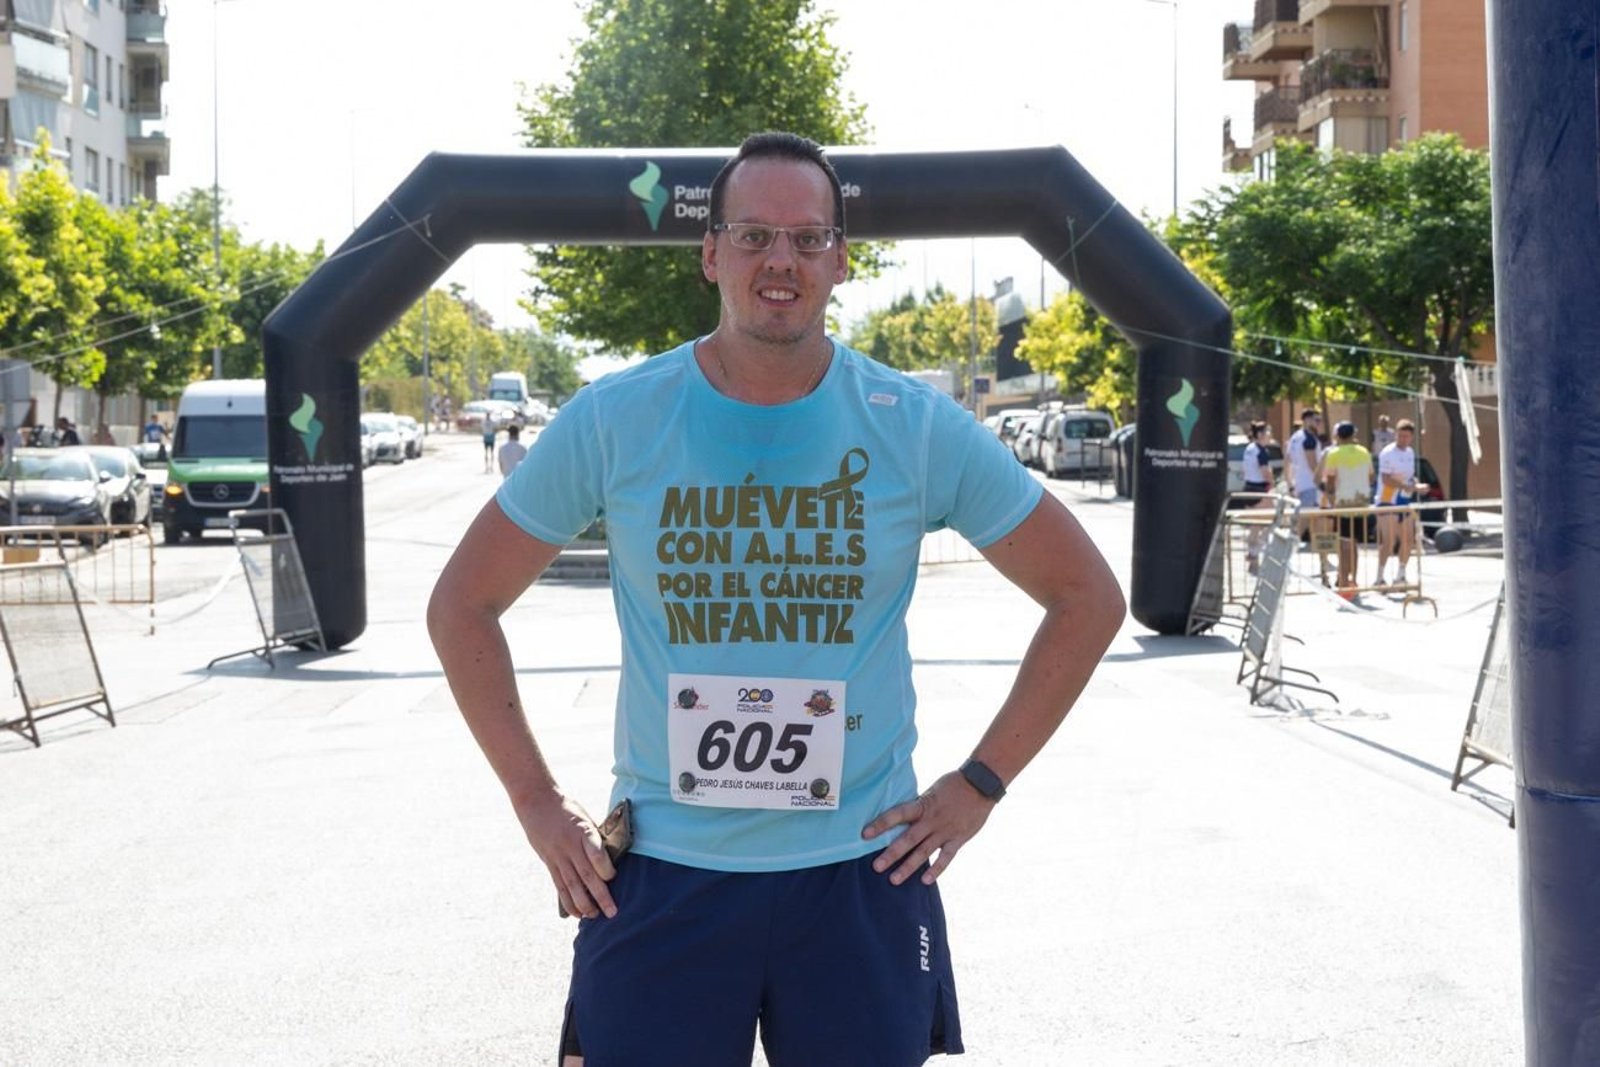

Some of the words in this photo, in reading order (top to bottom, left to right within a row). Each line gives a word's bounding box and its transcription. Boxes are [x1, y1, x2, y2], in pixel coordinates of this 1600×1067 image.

[674, 203, 710, 221] Dep
[658, 472, 866, 531] MUÉVETE
[656, 531, 732, 565] CON
[744, 531, 867, 567] A.L.E.S
[657, 572, 713, 598] POR
[722, 572, 751, 598] EL
[760, 566, 865, 600] CÁNCER
[663, 601, 855, 645] INFANTIL
[697, 720, 813, 774] 605
[695, 778, 718, 788] PEDRO
[720, 779, 743, 790] JESÚS
[744, 780, 774, 791] CHAVES
[775, 782, 808, 792] LABELLA
[919, 925, 931, 972] RUN
